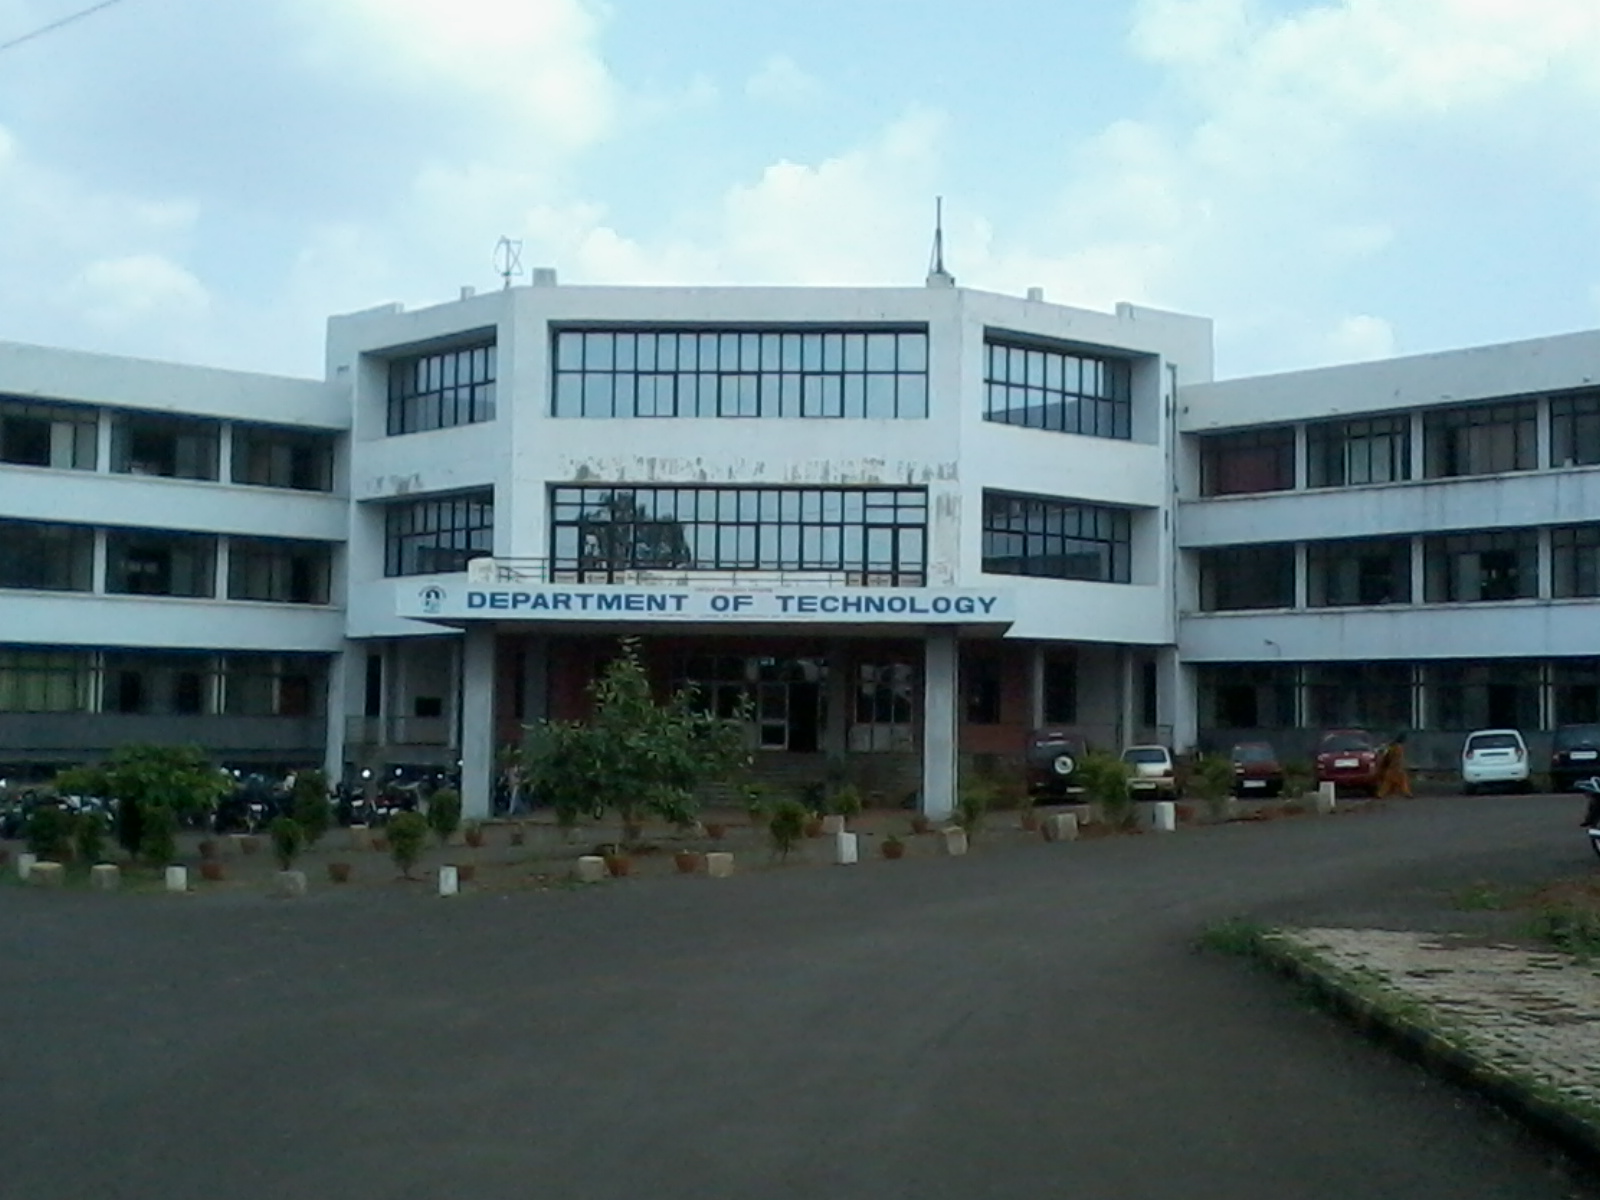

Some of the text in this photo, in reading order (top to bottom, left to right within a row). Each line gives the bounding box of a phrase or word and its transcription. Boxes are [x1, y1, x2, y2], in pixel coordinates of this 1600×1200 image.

[467, 591, 998, 614] DEPARTMENT OF TECHNOLOGY
